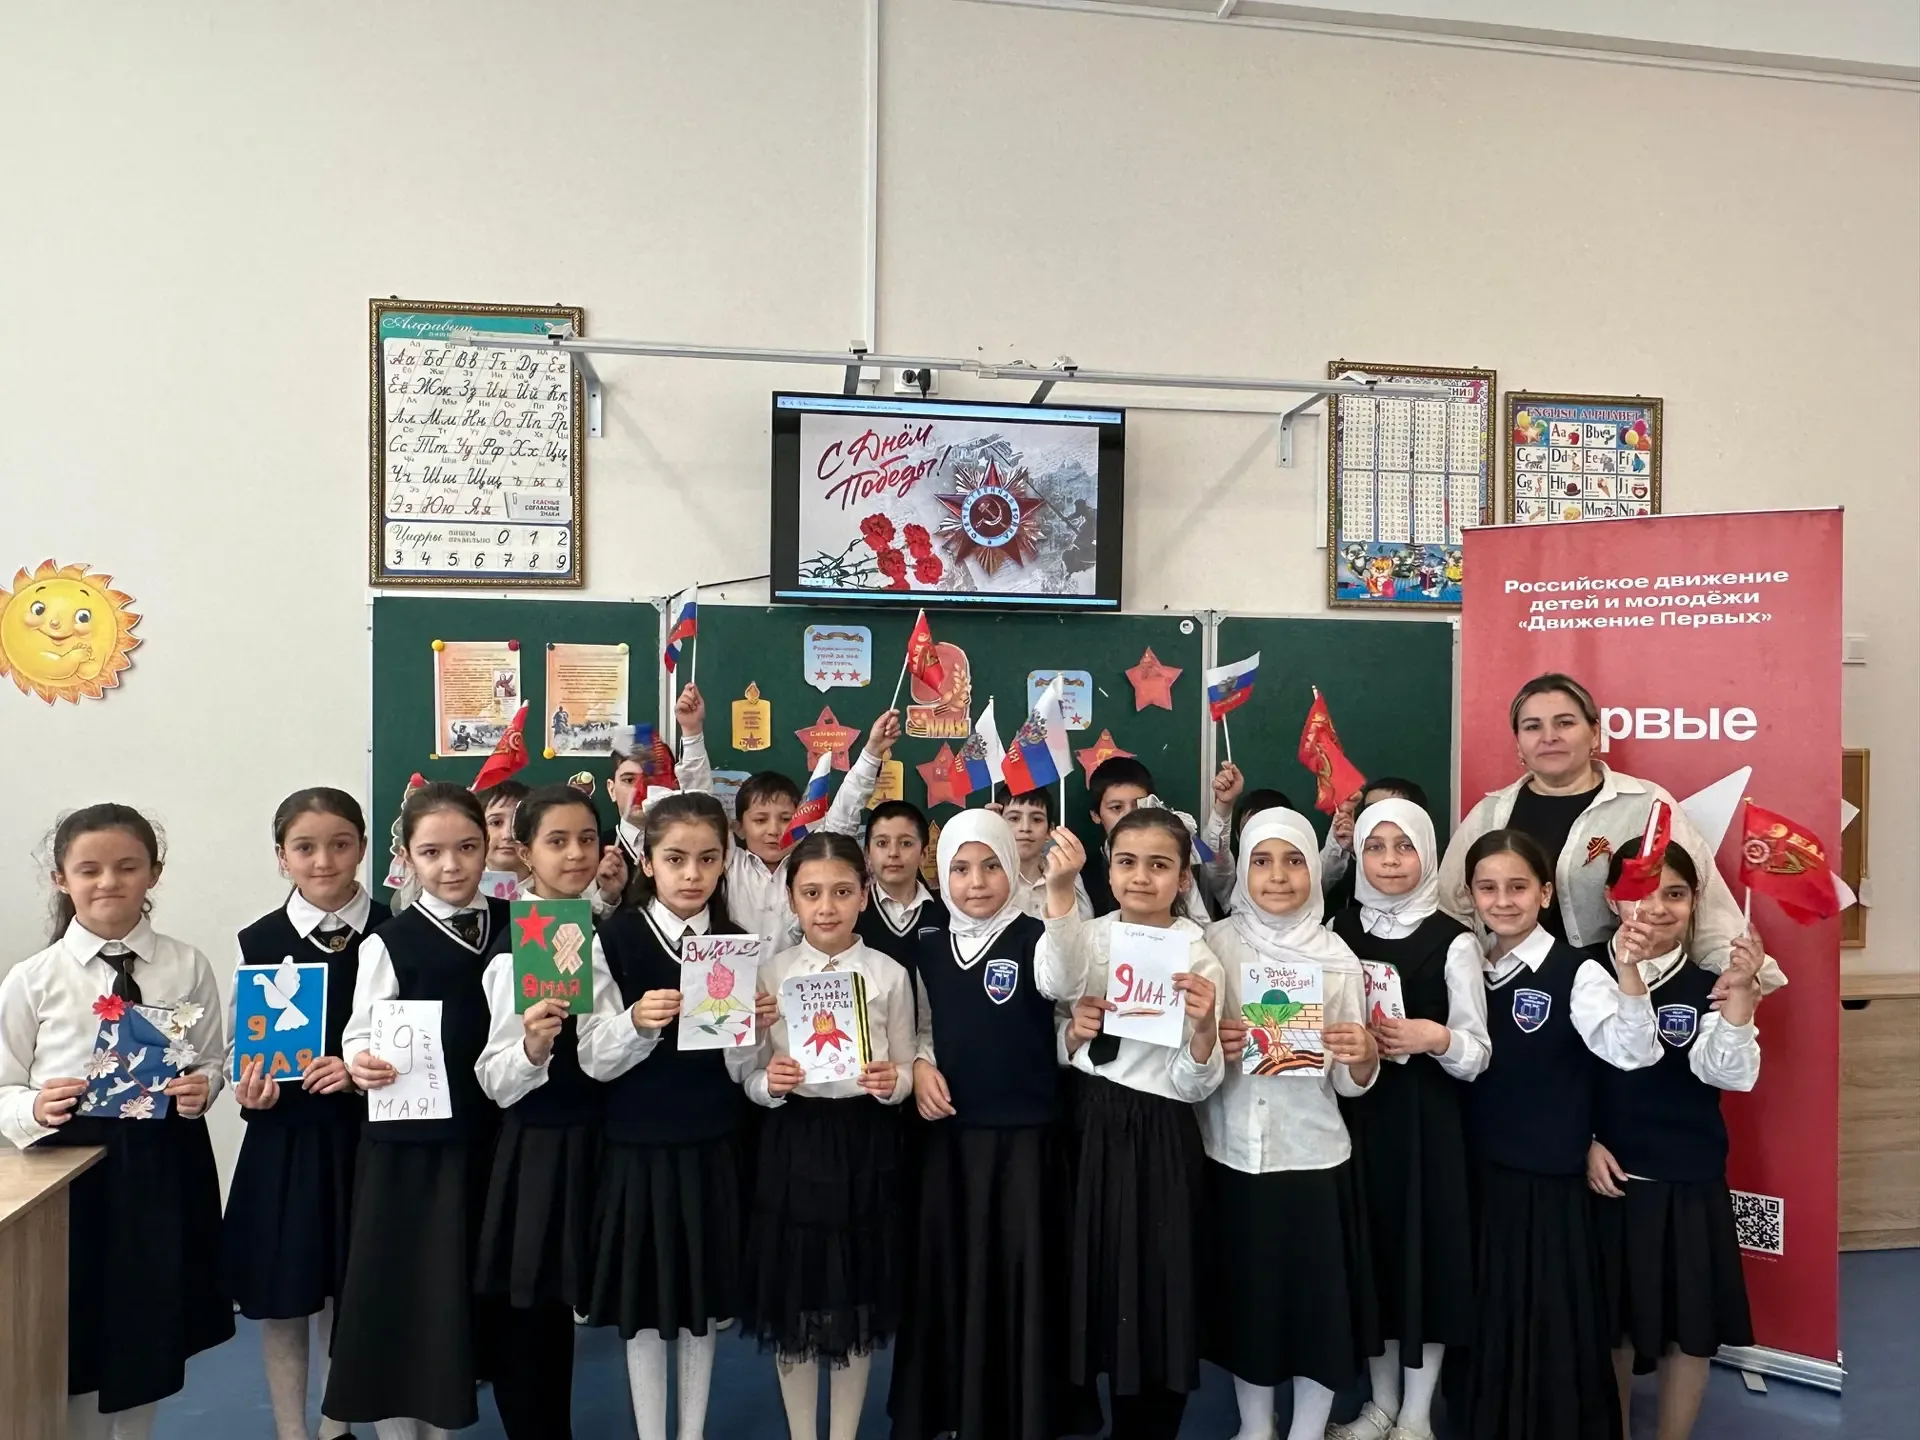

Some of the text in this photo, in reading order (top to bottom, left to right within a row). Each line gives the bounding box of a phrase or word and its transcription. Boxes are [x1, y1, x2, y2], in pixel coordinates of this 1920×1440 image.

[390, 348, 415, 366] Аа
[424, 350, 451, 366] Бб
[455, 351, 478, 368] Вв
[549, 356, 566, 373] Ее
[389, 374, 568, 403] Ёё Жж Зз Ии Йй Кк
[389, 408, 568, 433] Лл Мм Нн Оо Пп Рр
[1527, 407, 1641, 421] ENGLISH ALPHABET
[1552, 423, 1600, 439] Aa Bb
[389, 435, 568, 462] Сс Тт Уу Фф Хх Цц
[817, 423, 934, 481] С Днём
[1517, 447, 1631, 465] Cc Dd Ee Ff
[392, 465, 411, 482] Чч
[423, 466, 457, 484] Шш
[467, 467, 502, 490] Щщ
[825, 444, 951, 511] Победы!
[1517, 474, 1532, 492] Gg
[1551, 475, 1566, 489] Hh
[390, 495, 491, 515] Ээ Юю Яя
[1517, 500, 1531, 514] Kk
[1585, 502, 1604, 516] Mm
[1620, 503, 1635, 516] Nn
[390, 524, 443, 549] Цифры
[497, 529, 568, 546] 0 1 2
[393, 550, 567, 568] 3 4 5 6 7 8 9
[1504, 569, 1790, 594] Российское движение
[1529, 591, 1760, 612] детей и молодёжи
[1518, 610, 1772, 632] «Движение Первых»
[926, 719, 969, 739] МАЯ
[1601, 705, 1758, 753] рвые
[522, 973, 581, 998] 9 МАЯ
[810, 980, 841, 991] МАЯ
[1114, 963, 1180, 1008] 9 МАЯ
[800, 993, 808, 1002] С
[803, 1000, 853, 1011] ПОБЕДЫ
[389, 1003, 405, 1015] ЗА
[248, 1015, 267, 1041] 9
[393, 1024, 414, 1075] 9
[375, 1097, 436, 1120] МАЯ!
